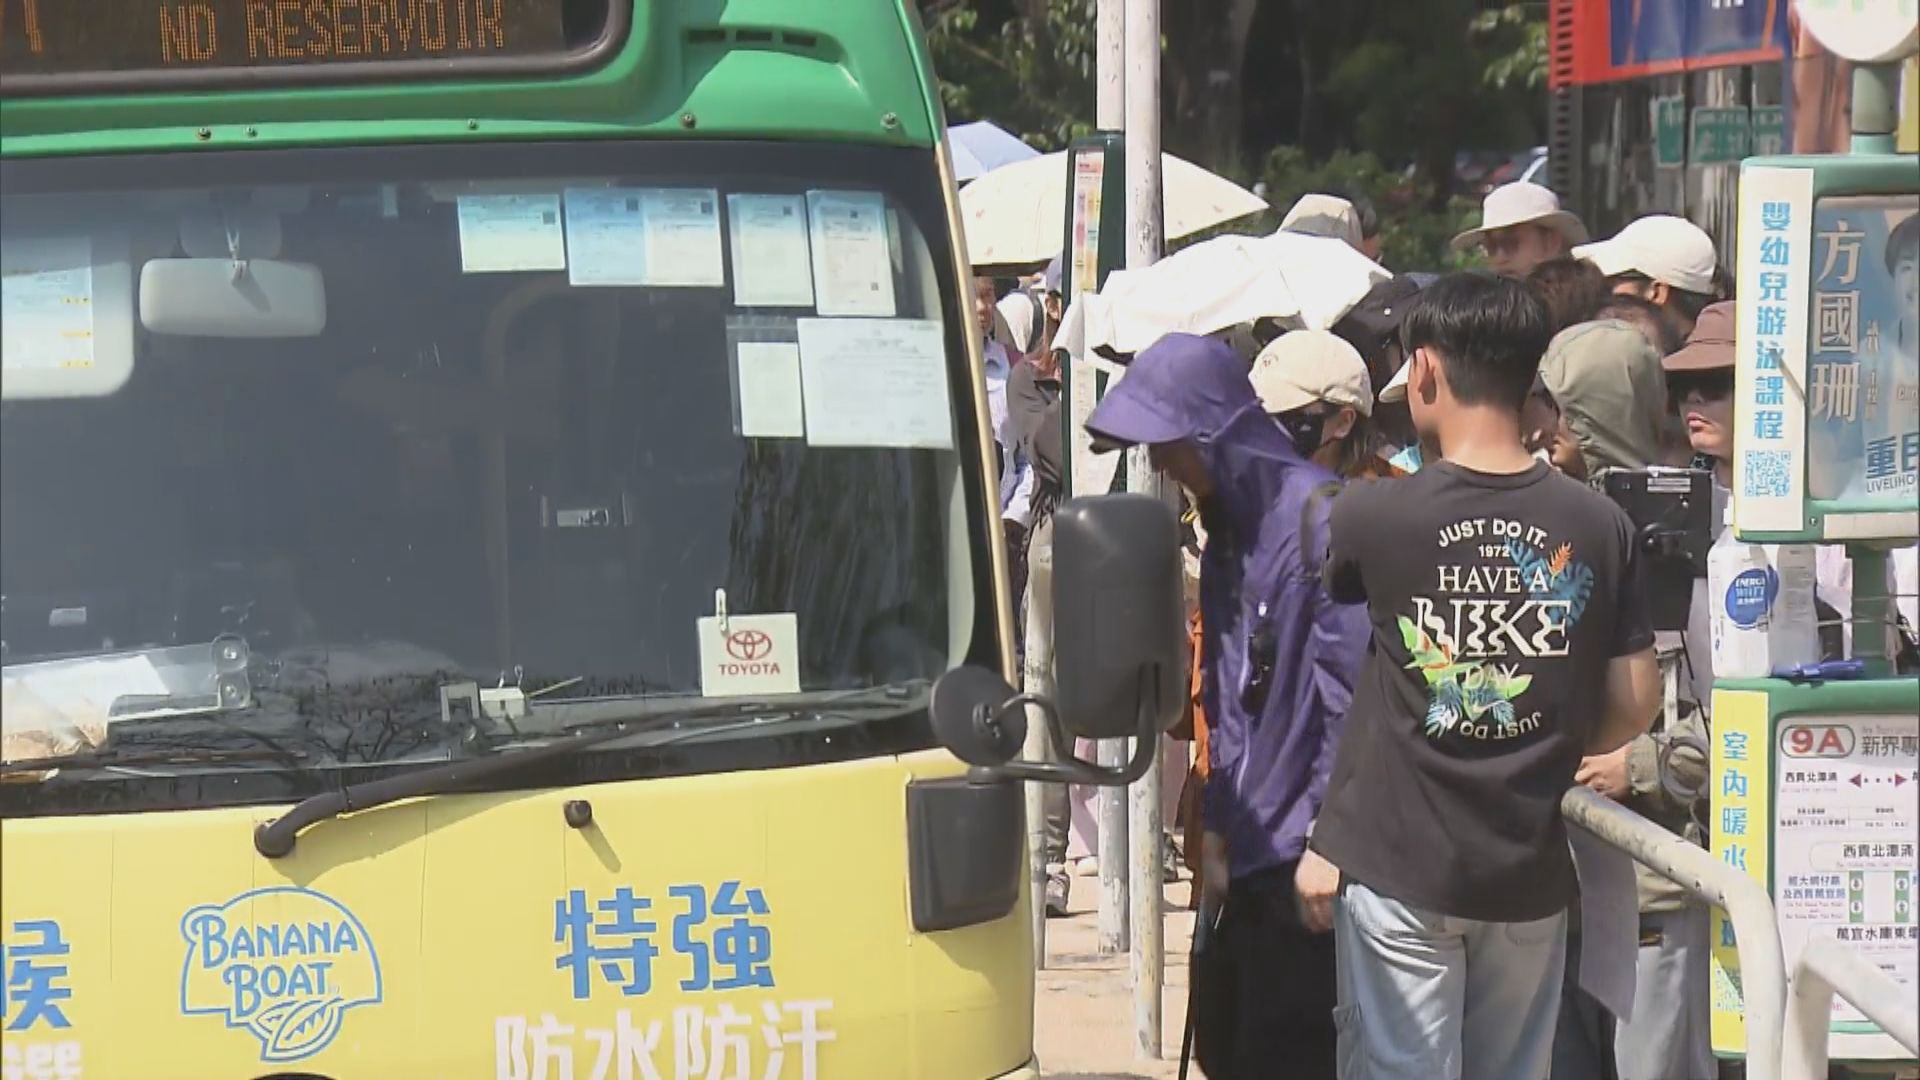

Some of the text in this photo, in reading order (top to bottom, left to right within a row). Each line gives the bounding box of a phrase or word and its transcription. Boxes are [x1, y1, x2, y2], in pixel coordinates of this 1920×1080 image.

[245, 0, 504, 58] RESERVOIR
[1752, 201, 1791, 440] 嬰幼兒游泳課程
[1810, 220, 1866, 425] 方國珊
[1438, 517, 1548, 550] JUST DO IT.
[1478, 543, 1511, 558] 1972
[1436, 565, 1550, 593] HAVE A
[1410, 596, 1572, 657] NIKE
[718, 662, 781, 676] TOYOTA
[1464, 662, 1520, 689] DAY
[1459, 711, 1542, 740] JUST DO
[1790, 725, 1846, 754] 9A
[190, 913, 359, 969] BANANA
[553, 880, 776, 999] 特強
[222, 961, 333, 1018] BOAT
[493, 999, 838, 1080] 防水防汗
